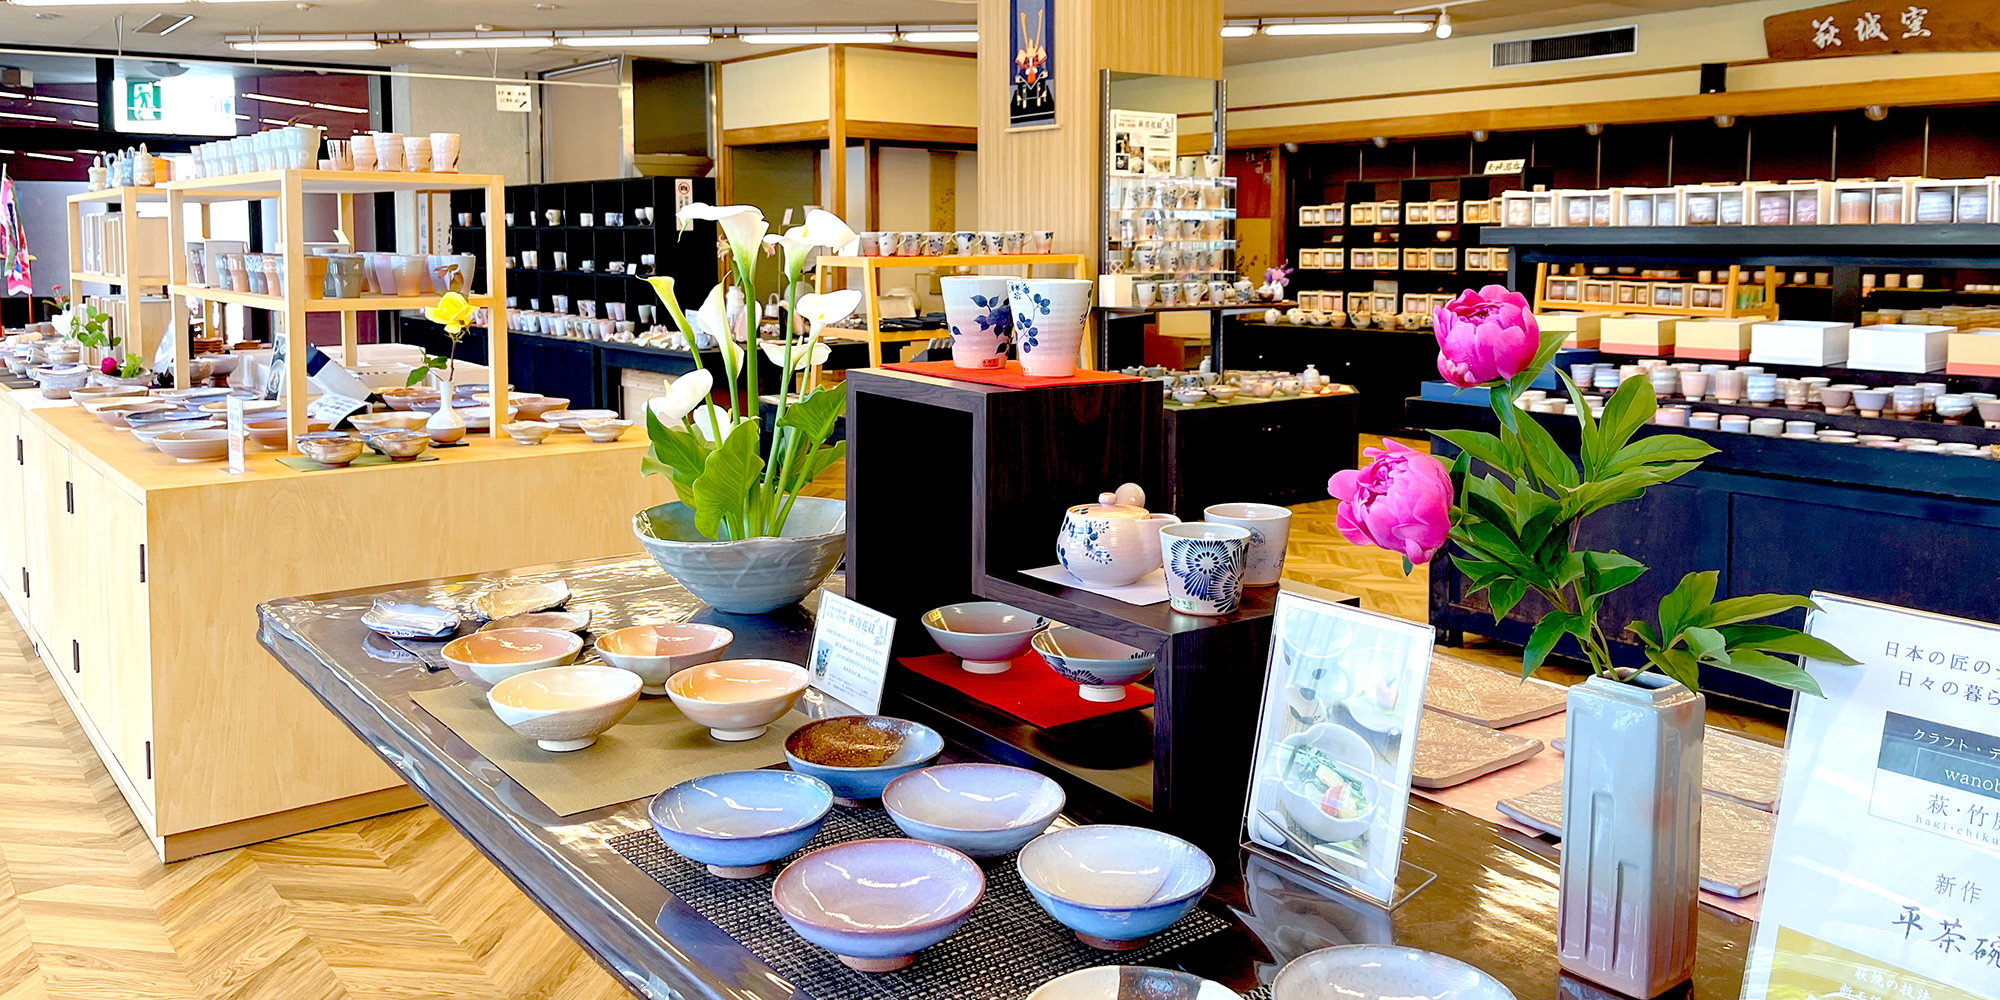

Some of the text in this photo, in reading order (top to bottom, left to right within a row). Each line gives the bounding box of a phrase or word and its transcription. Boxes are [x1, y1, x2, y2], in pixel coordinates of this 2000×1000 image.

[1812, 6, 1932, 49] 萩城窯
[1885, 641, 2000, 680] 日本の匠の
[1934, 872, 1983, 904] 新作
[1892, 905, 2000, 968] 平茶碗
